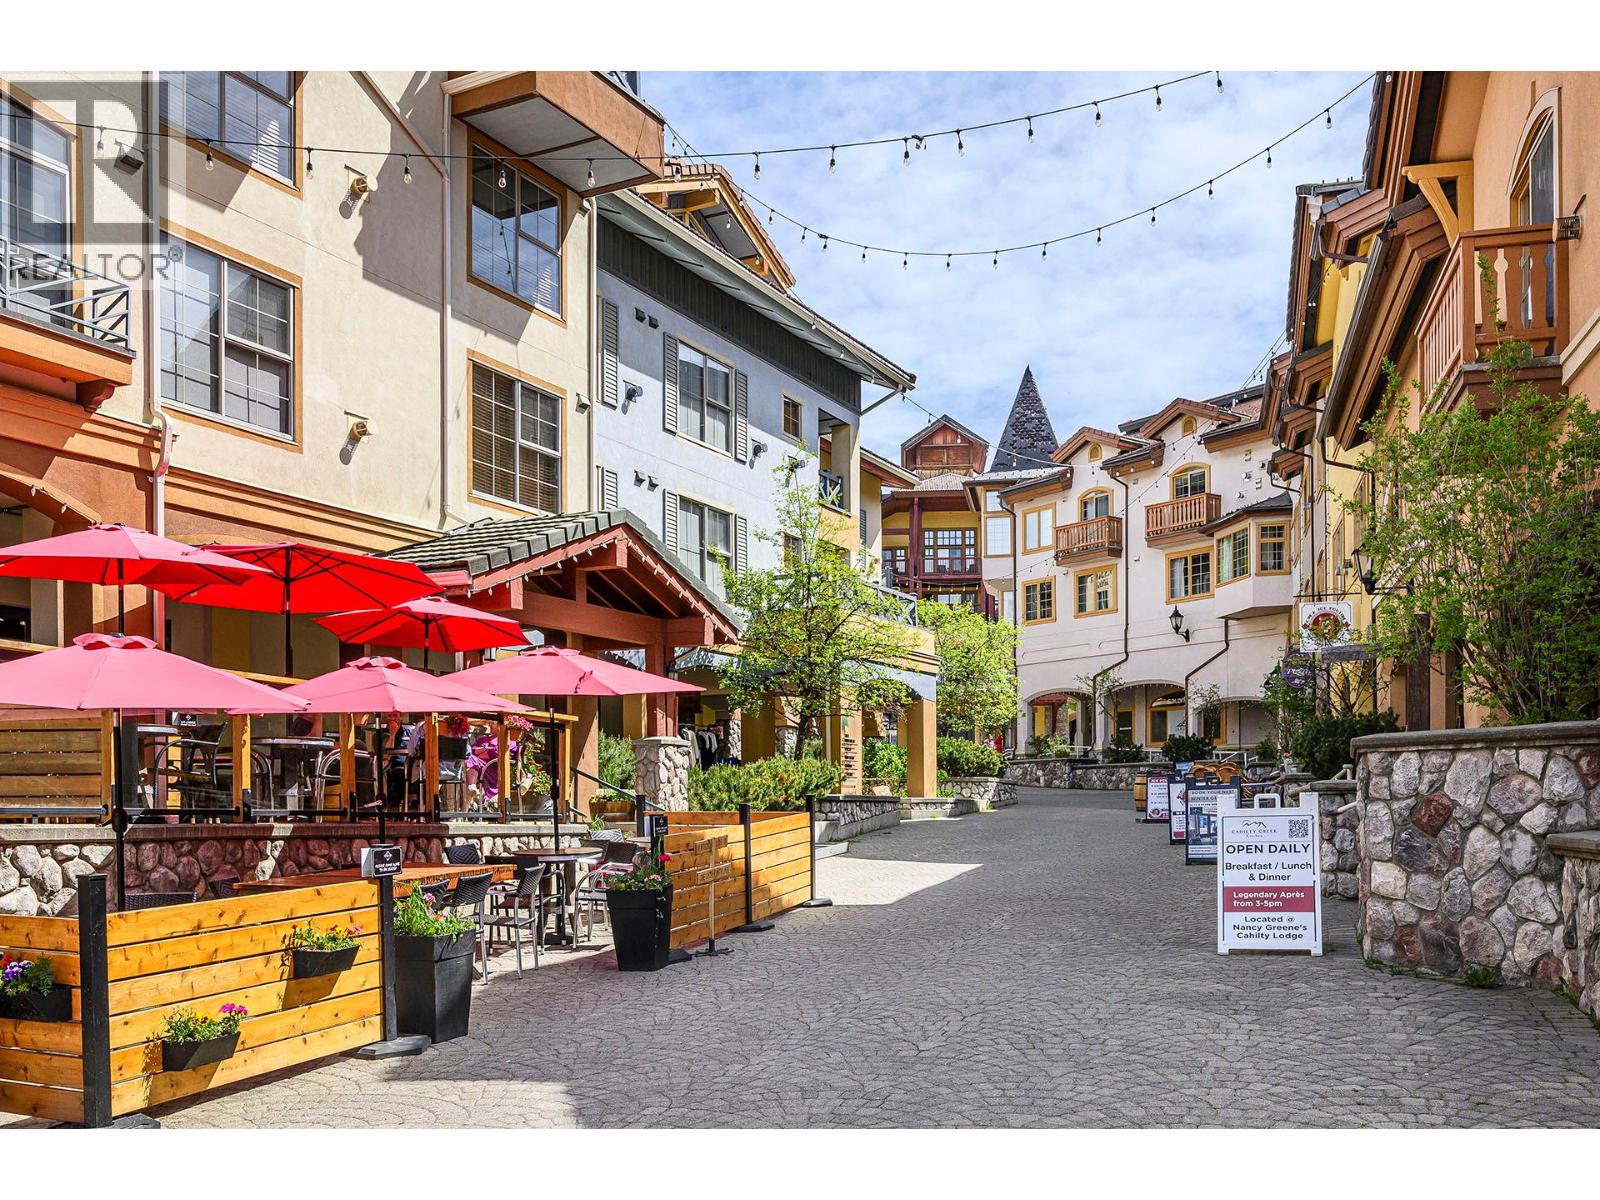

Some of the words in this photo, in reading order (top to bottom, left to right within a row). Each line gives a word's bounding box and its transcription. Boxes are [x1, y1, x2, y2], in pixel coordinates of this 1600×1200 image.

[1226, 844, 1264, 854] OPEN
[1268, 843, 1311, 853] DAILY
[1225, 862, 1272, 870] Breakfast
[1281, 862, 1312, 870] Lunch
[1248, 873, 1256, 881] &
[1258, 873, 1291, 881] Dinner
[1233, 891, 1277, 899] Legendary
[1280, 891, 1305, 899] Après
[1255, 900, 1283, 908] 3-5pm
[1236, 932, 1270, 940] Cahilty
[1273, 932, 1304, 940] Lodge
